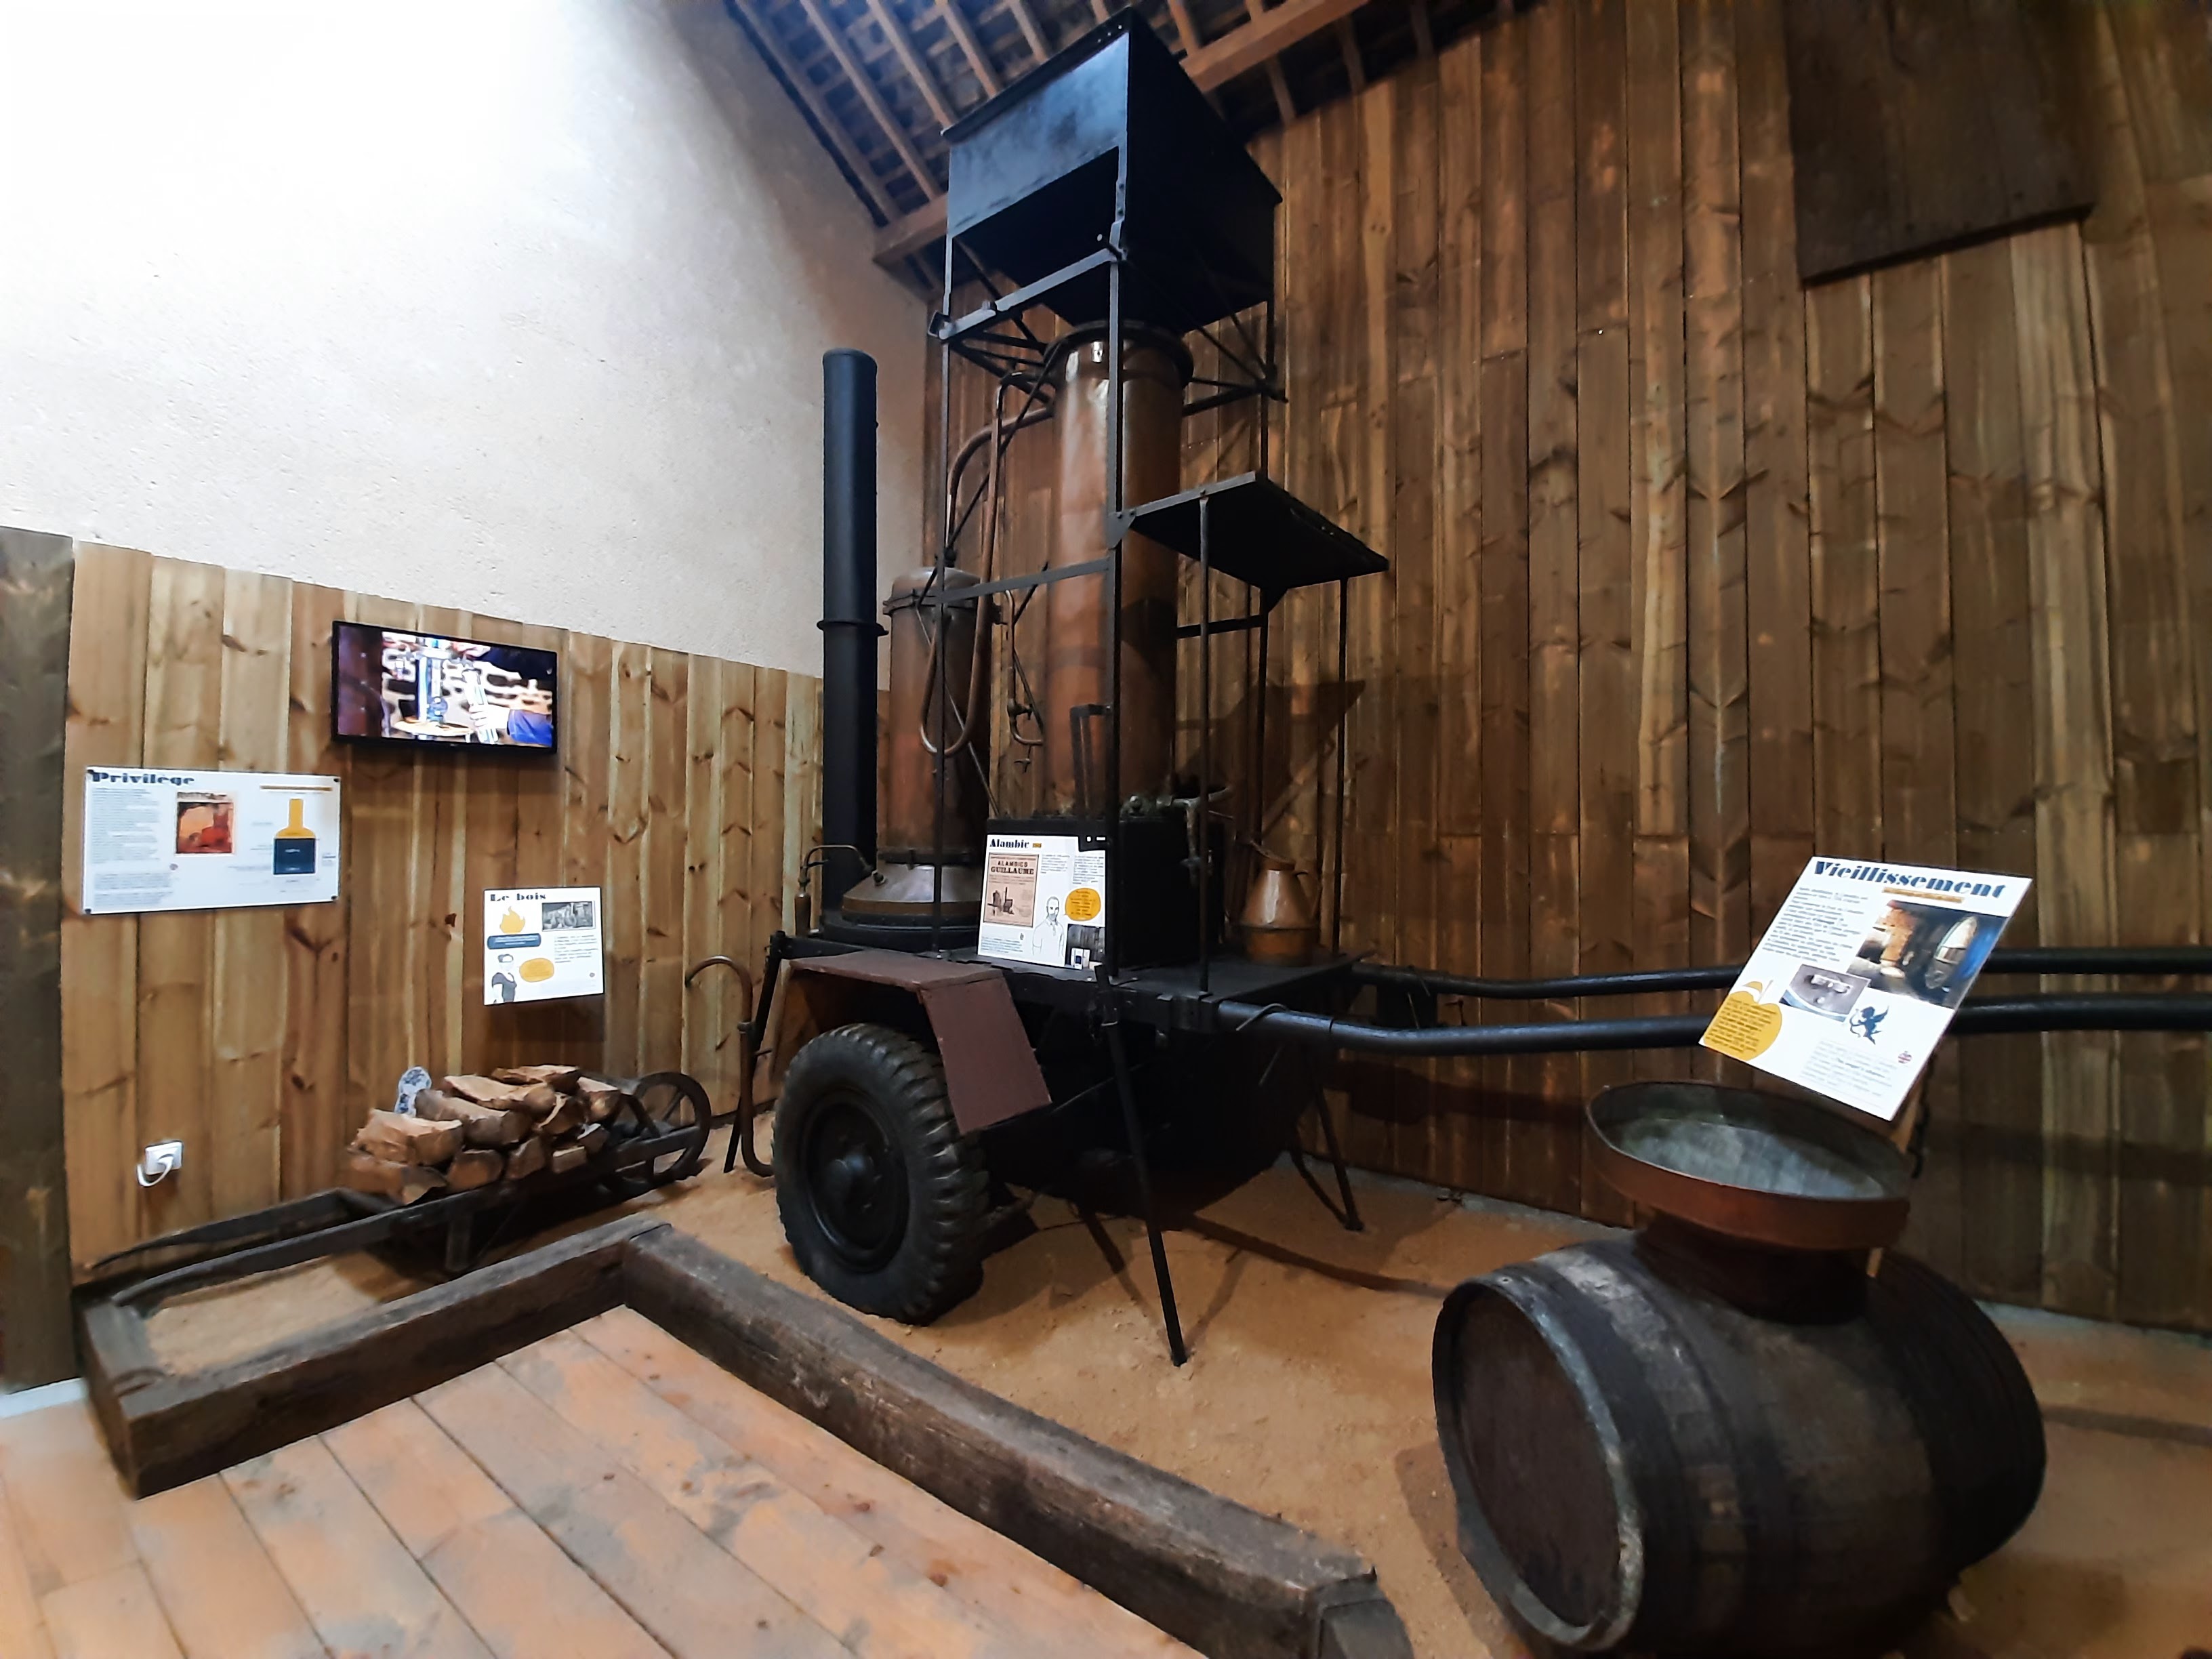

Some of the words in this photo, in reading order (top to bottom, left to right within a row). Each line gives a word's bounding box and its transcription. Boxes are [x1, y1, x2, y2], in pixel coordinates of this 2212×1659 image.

[989, 838, 1029, 848] Alambic
[991, 866, 1034, 875] GUILLAUME
[1814, 861, 2006, 898] Vieillissement
[516, 893, 546, 901] bois
